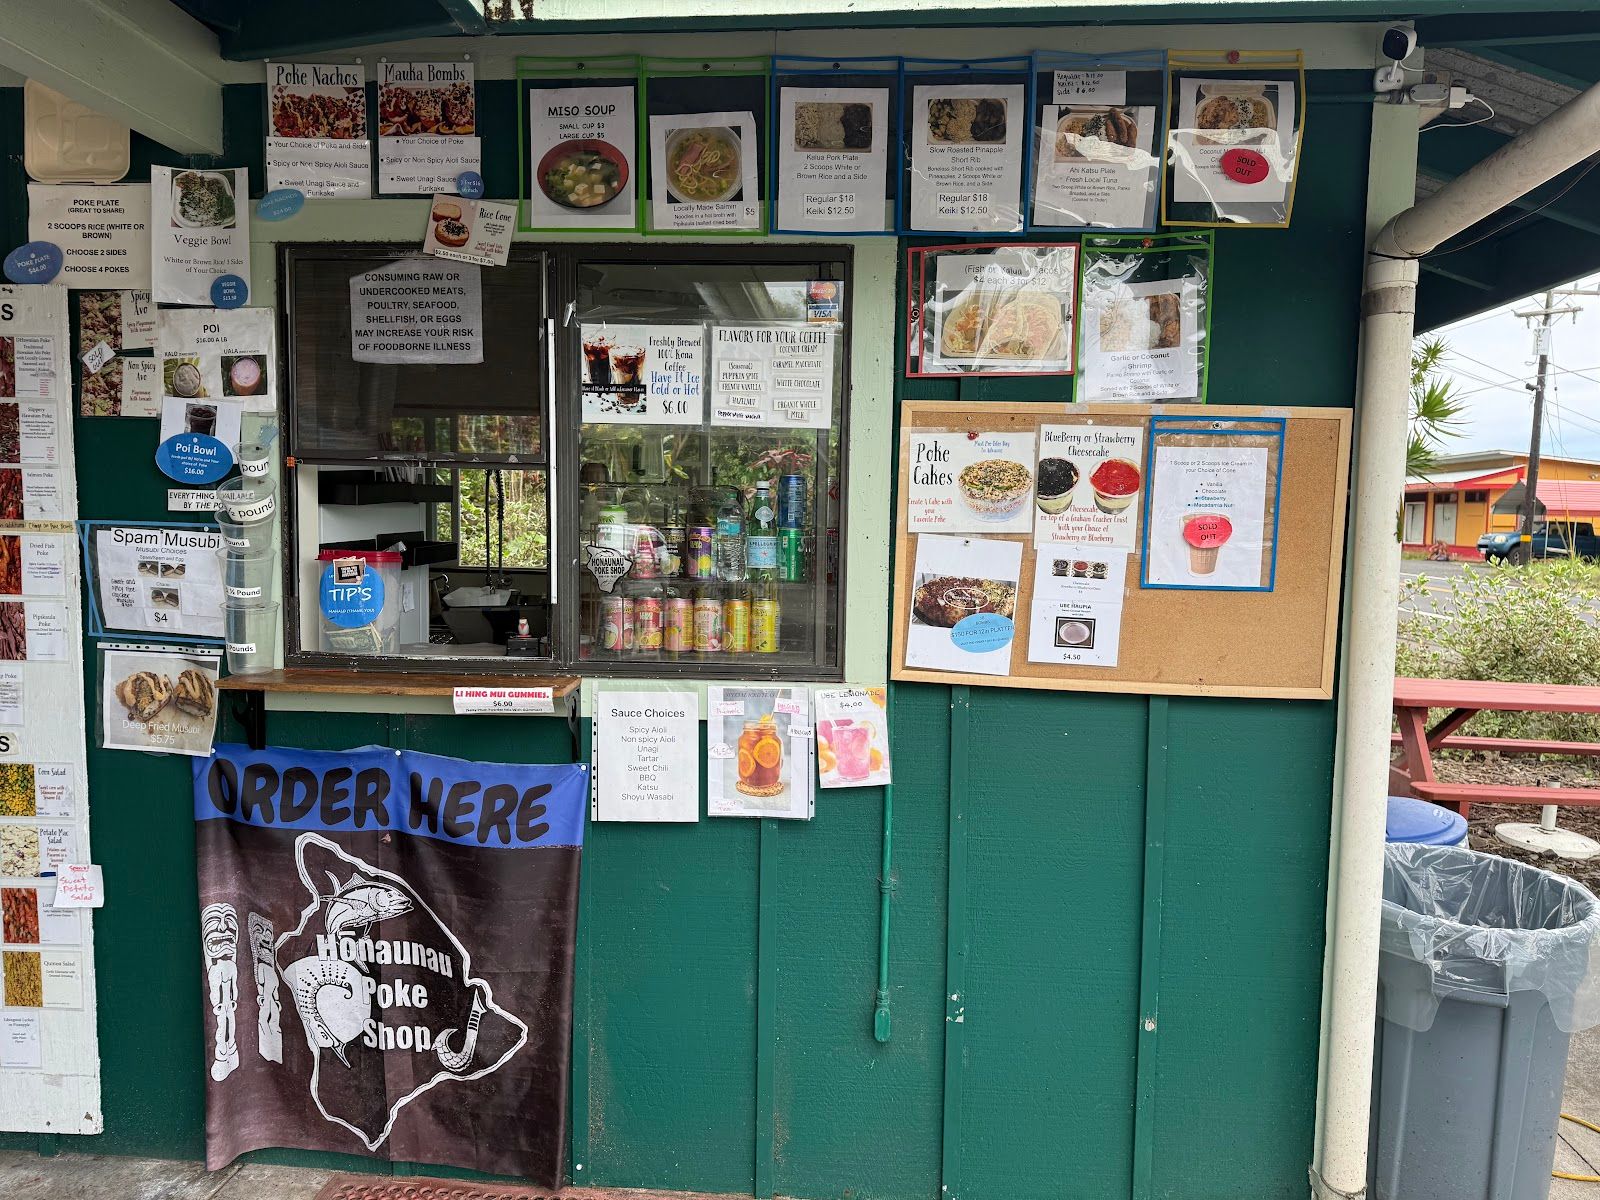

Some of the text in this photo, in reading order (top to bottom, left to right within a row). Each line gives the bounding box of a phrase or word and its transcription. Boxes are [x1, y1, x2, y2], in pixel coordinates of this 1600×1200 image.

[276, 64, 357, 86] Poke Nachos
[428, 64, 465, 82] Bombs
[547, 105, 616, 116] MISO SOUP
[581, 122, 595, 130] CUP
[596, 121, 605, 130] $3
[559, 132, 605, 140] LARGE CUP $5
[929, 146, 945, 154] Slow
[946, 146, 974, 154] Roasted
[951, 156, 981, 164] Short Rib
[1236, 156, 1257, 167] SOLD
[1235, 167, 1251, 177] OUT
[73, 199, 120, 207] POKE PLATE
[806, 194, 854, 204] Regular $18
[939, 193, 988, 204] Regular $18
[67, 207, 125, 215] (GREAT TO SHARE)
[479, 207, 494, 220] Rice
[806, 206, 855, 215] Keiki $12.50
[939, 206, 988, 215] Keiki $12.50
[47, 223, 144, 232] 2 SCOOPS RICE (WHITE OR
[82, 231, 112, 240] BROWN)
[174, 235, 232, 248] Veggie Bowl
[66, 248, 127, 257] CHOOSE 2 SIDES
[64, 265, 130, 273] CHOOSE 4 POKES
[364, 272, 460, 281] CONSUMING RAW OR
[359, 286, 466, 297] UNDERCOOKED MEATS,
[367, 301, 460, 311] POULTRY, SEAFOOD,
[813, 310, 832, 318] VISA
[366, 315, 462, 325] SHELLFISH, OR EGGS
[203, 324, 220, 334] POI
[355, 329, 474, 338] MAY INCREASE YOUR RISK
[648, 335, 701, 348] Freshly Brewed
[718, 330, 828, 346] FLAVORS FOR YOUR COFFEE
[358, 343, 471, 352] OF FOODBORNE ILLNESS
[675, 348, 693, 360] Kona
[1140, 352, 1170, 362] Coconut
[664, 361, 687, 372] Coffee
[1127, 362, 1152, 371] Shrimp
[651, 372, 700, 384] Have It Ice
[651, 384, 671, 396] Cold
[673, 386, 682, 396] or
[683, 384, 699, 396] Hot
[662, 400, 688, 415] $6.00
[1044, 431, 1136, 446] BlueBerry or Strawberry
[175, 443, 217, 456] Poi Bowl
[915, 440, 950, 464] Poke
[1067, 445, 1110, 458] Cheesecake
[184, 467, 204, 475] $16.00
[912, 464, 953, 487] Cakes
[169, 492, 215, 500] EVERYTHING
[238, 499, 274, 519] pound
[1198, 523, 1218, 531] SOLD
[113, 528, 220, 549] Spam Musubi
[1200, 533, 1217, 541] OUT
[135, 545, 188, 555] Musubi Choices
[591, 557, 625, 567] HONAUNAU
[594, 566, 626, 576] POKE SHOP
[328, 587, 372, 602] TIP'S
[1059, 602, 1071, 610] UBE
[153, 611, 169, 624] $4
[1062, 653, 1081, 662] $4.50
[455, 690, 550, 700] LI HING MUI GUMMIES.
[820, 690, 881, 700] UBE LEMONADE
[839, 700, 863, 710] $4.00
[611, 708, 685, 719] Sauce Choices
[122, 720, 200, 734] Deep Fried Musubi
[629, 725, 668, 735] Spicy Aioli
[150, 735, 175, 744] $5.75
[621, 735, 676, 745] Non spicy Aioli
[637, 745, 659, 755] Unagi
[637, 754, 659, 763] Tartar
[51, 767, 66, 776] Salad
[627, 764, 669, 773] Sweet Chili
[639, 773, 657, 783] BBQ
[637, 783, 659, 792] Katsu
[207, 758, 553, 845] ORDER HERE
[621, 793, 674, 803] Shoyu Wasabi
[316, 930, 453, 979] Hōnaunau
[361, 975, 428, 1009] Poke
[363, 1017, 433, 1053] Shop
